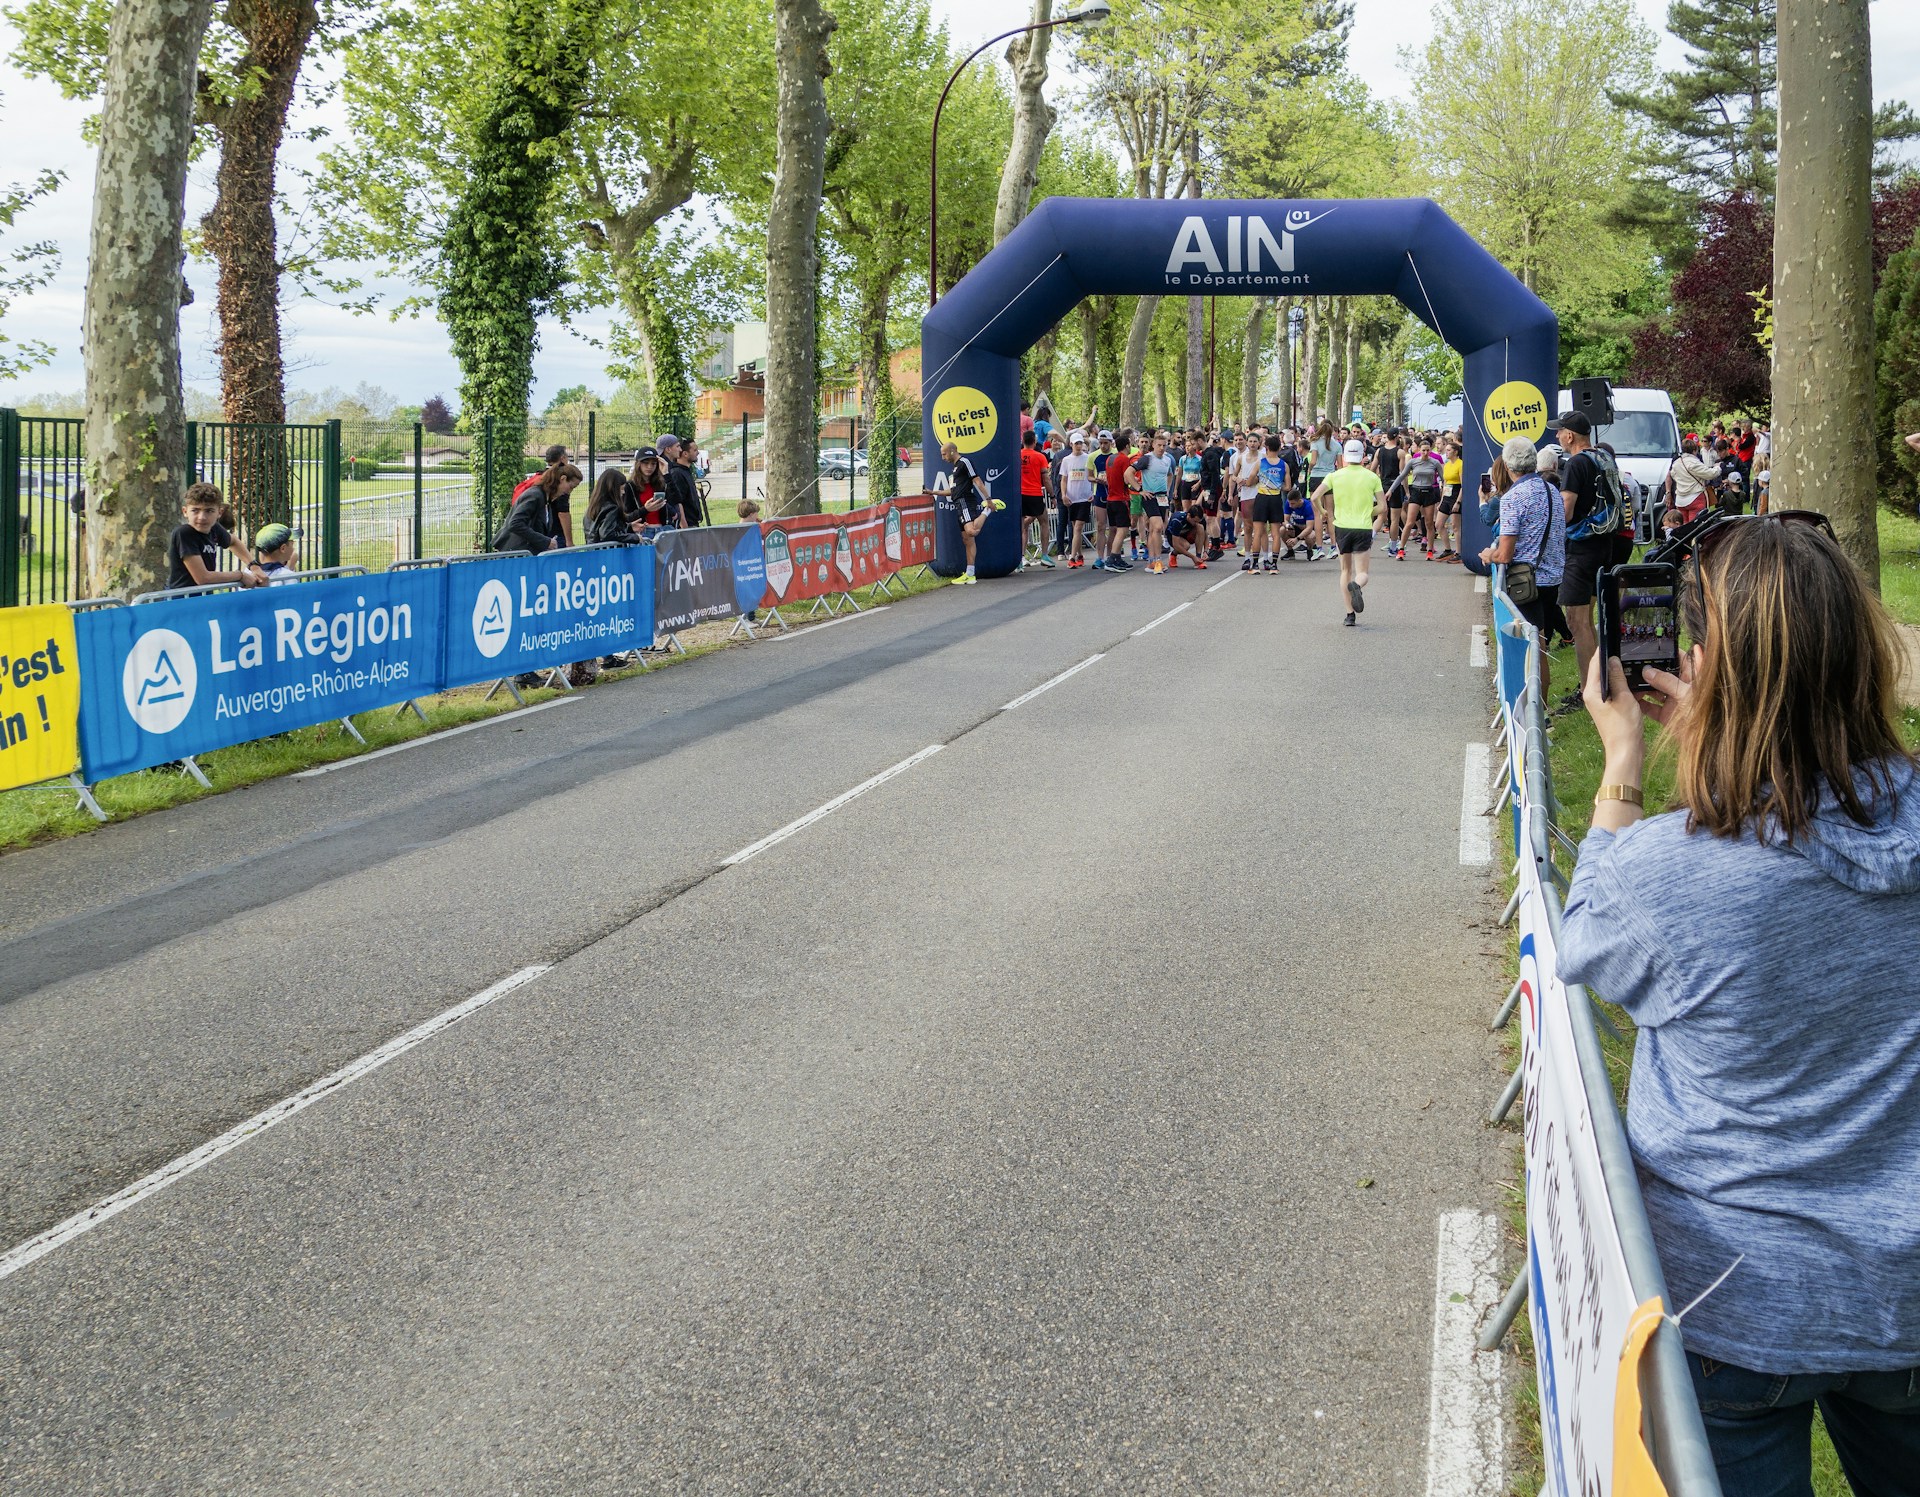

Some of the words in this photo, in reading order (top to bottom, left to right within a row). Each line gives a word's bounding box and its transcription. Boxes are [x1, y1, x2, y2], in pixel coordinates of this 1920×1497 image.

[1291, 210, 1310, 221] 01
[1165, 216, 1294, 272] AIN
[1165, 274, 1181, 285] le
[1189, 273, 1310, 286] Département
[938, 411, 956, 425] Ici,
[958, 406, 990, 422] c’est
[1491, 407, 1511, 420] Ici,
[1513, 400, 1542, 416] c’est
[947, 426, 976, 439] l’Ain
[979, 422, 985, 434] !
[1501, 419, 1530, 434] l’Ain
[1532, 416, 1537, 428] !
[933, 471, 992, 502] AN
[519, 575, 549, 618] La
[555, 565, 635, 616] Région
[1639, 597, 1656, 606] AIN
[208, 619, 263, 675] La
[274, 595, 412, 664] Région
[519, 614, 635, 653] Auvergne-Rhône-Alpes
[0, 637, 65, 696] ’est
[215, 658, 409, 721] Auvergne-Rhône-Alpes
